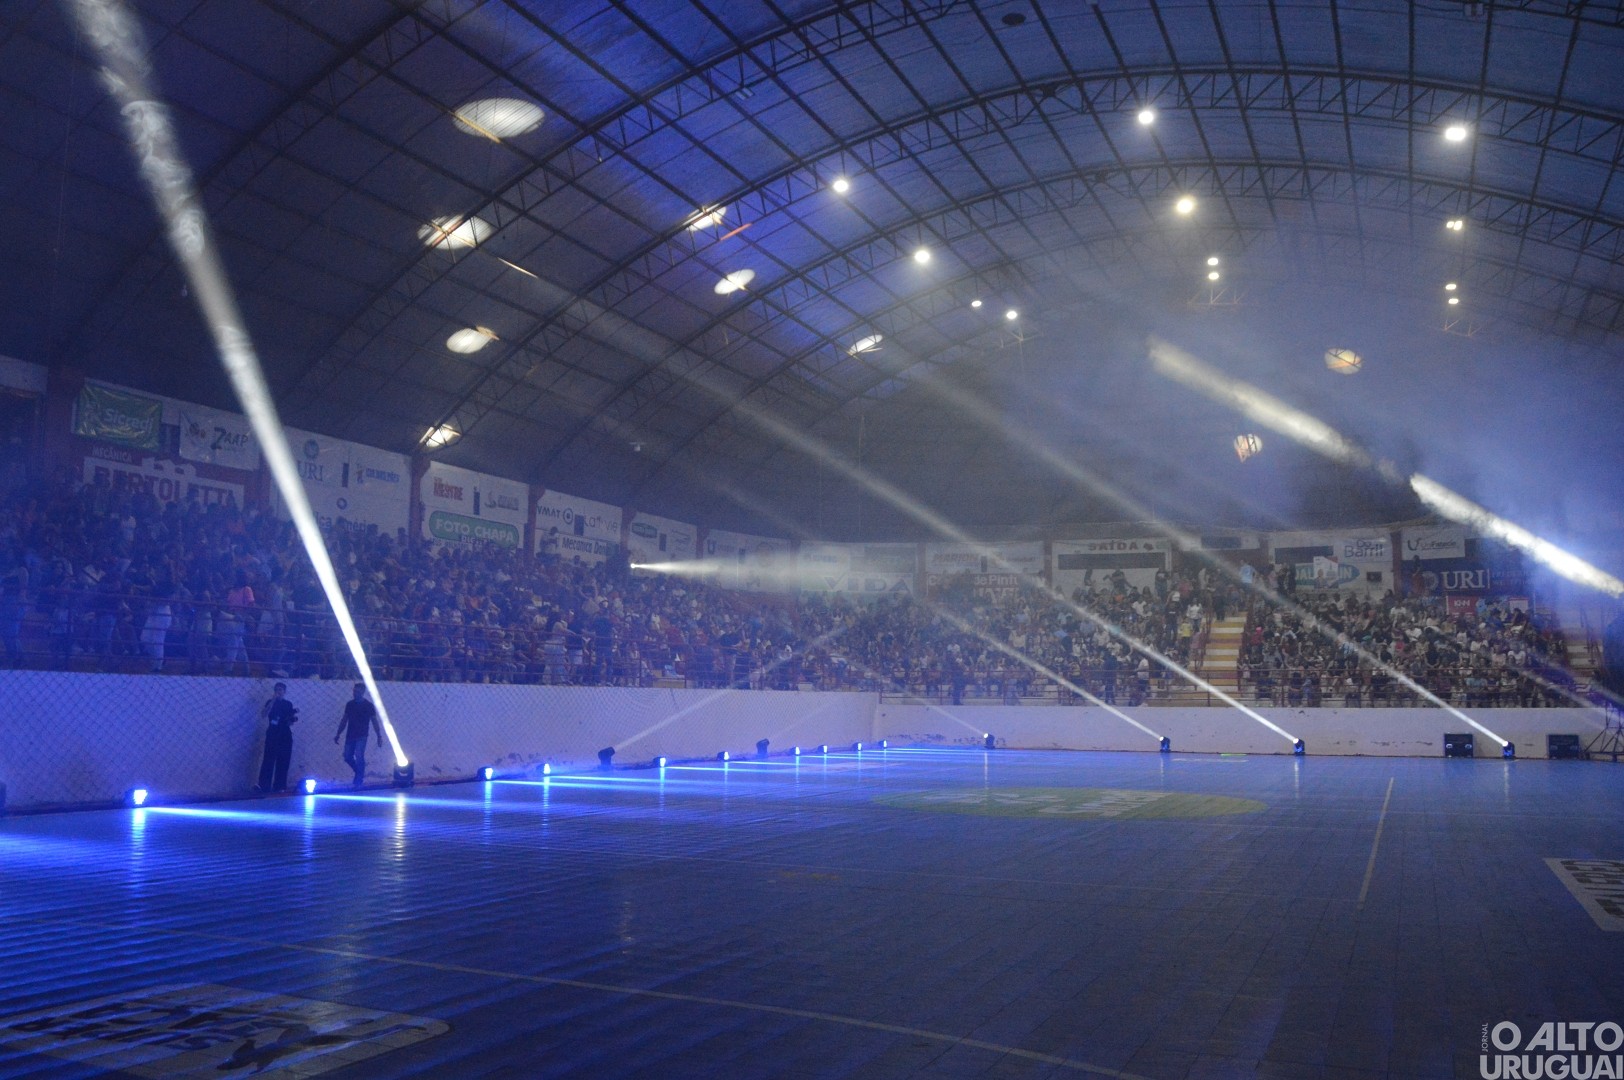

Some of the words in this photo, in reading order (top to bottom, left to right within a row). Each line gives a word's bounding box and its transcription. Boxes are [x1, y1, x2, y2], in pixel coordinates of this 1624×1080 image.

[103, 408, 154, 433] Sicredi
[435, 519, 471, 535] FOTO
[474, 526, 514, 543] CHAPA
[1440, 570, 1485, 589] URI
